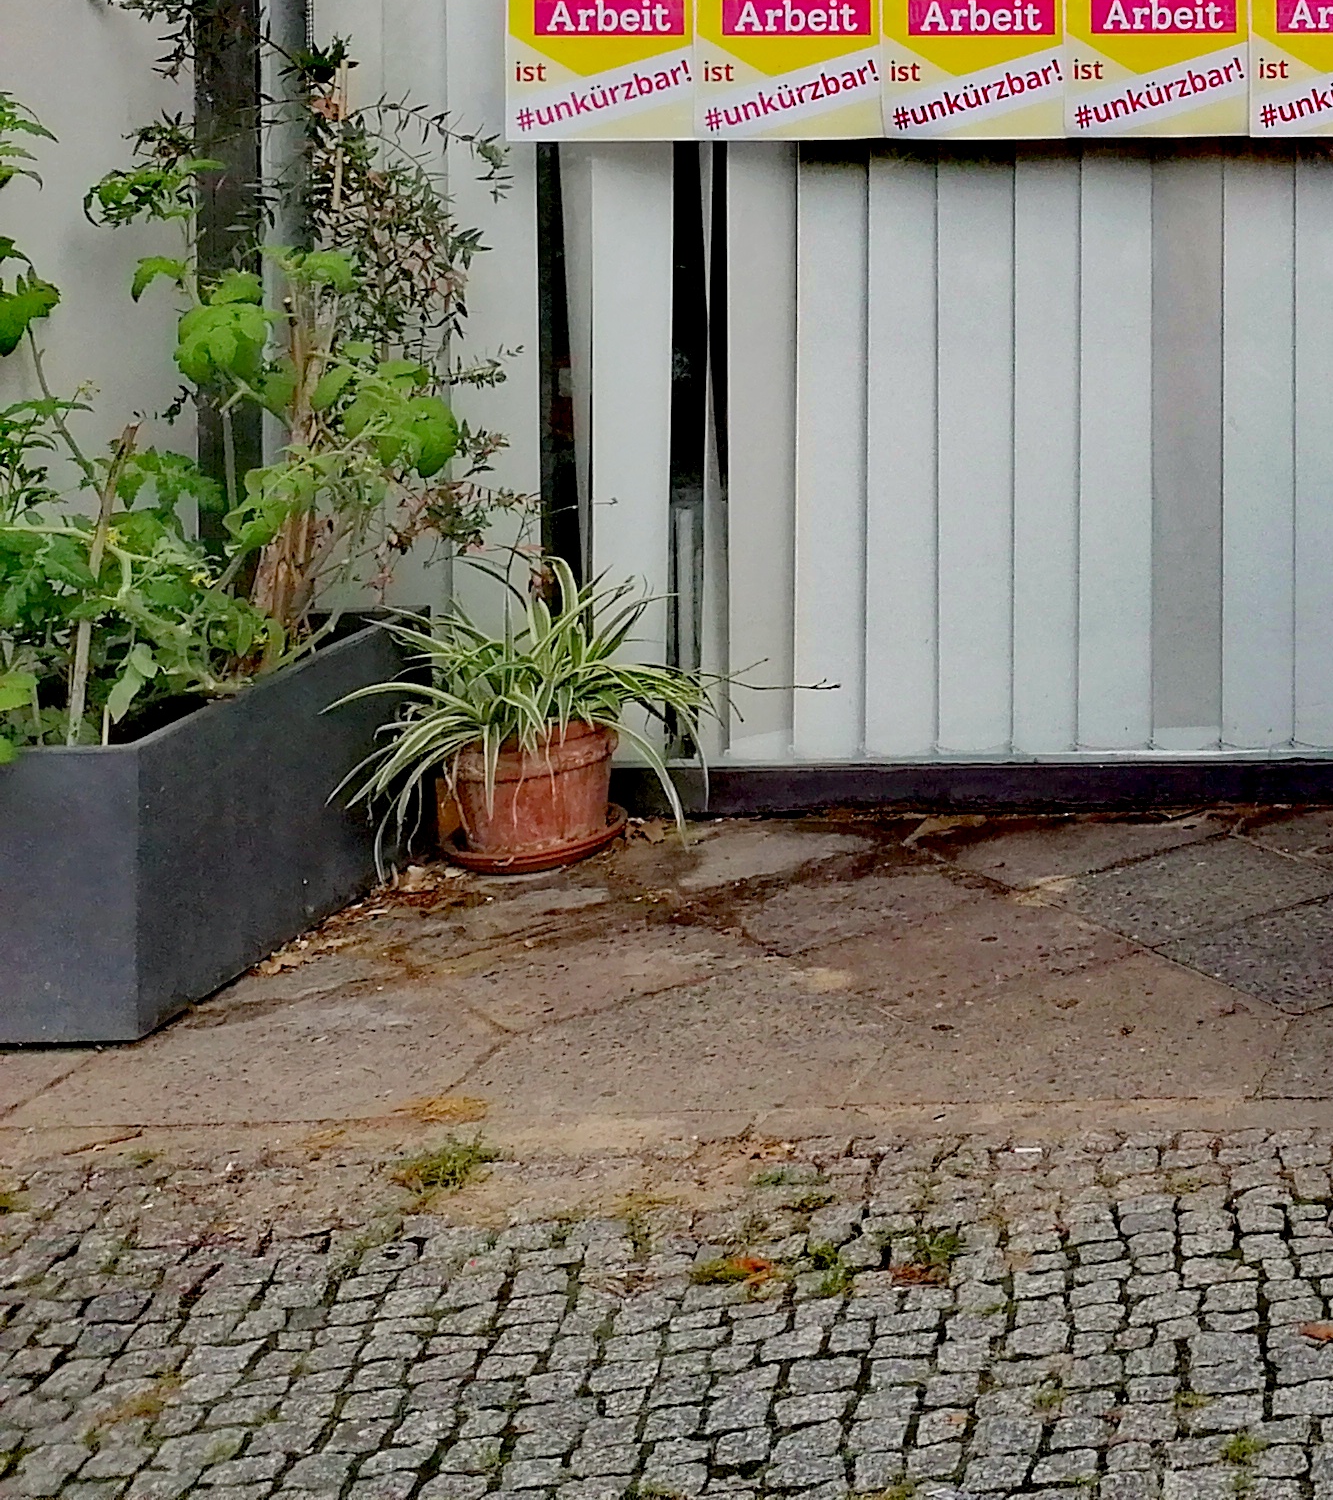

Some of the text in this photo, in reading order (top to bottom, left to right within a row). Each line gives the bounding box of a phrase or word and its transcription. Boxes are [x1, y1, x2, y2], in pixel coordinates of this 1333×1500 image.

[546, 0, 672, 32] Arbeit
[734, 0, 858, 32] Arbeit
[920, 0, 1043, 32] Arbeit
[516, 61, 547, 82] ist
[704, 60, 734, 82] ist
[890, 59, 921, 82] ist
[1073, 58, 1104, 80] ist
[1259, 57, 1289, 80] ist
[516, 59, 692, 132] #unkürzbar!
[704, 59, 880, 132] #unkürzbar!
[892, 58, 1063, 131] #unkürzbar!
[1074, 57, 1245, 130] #unkürzbar!
